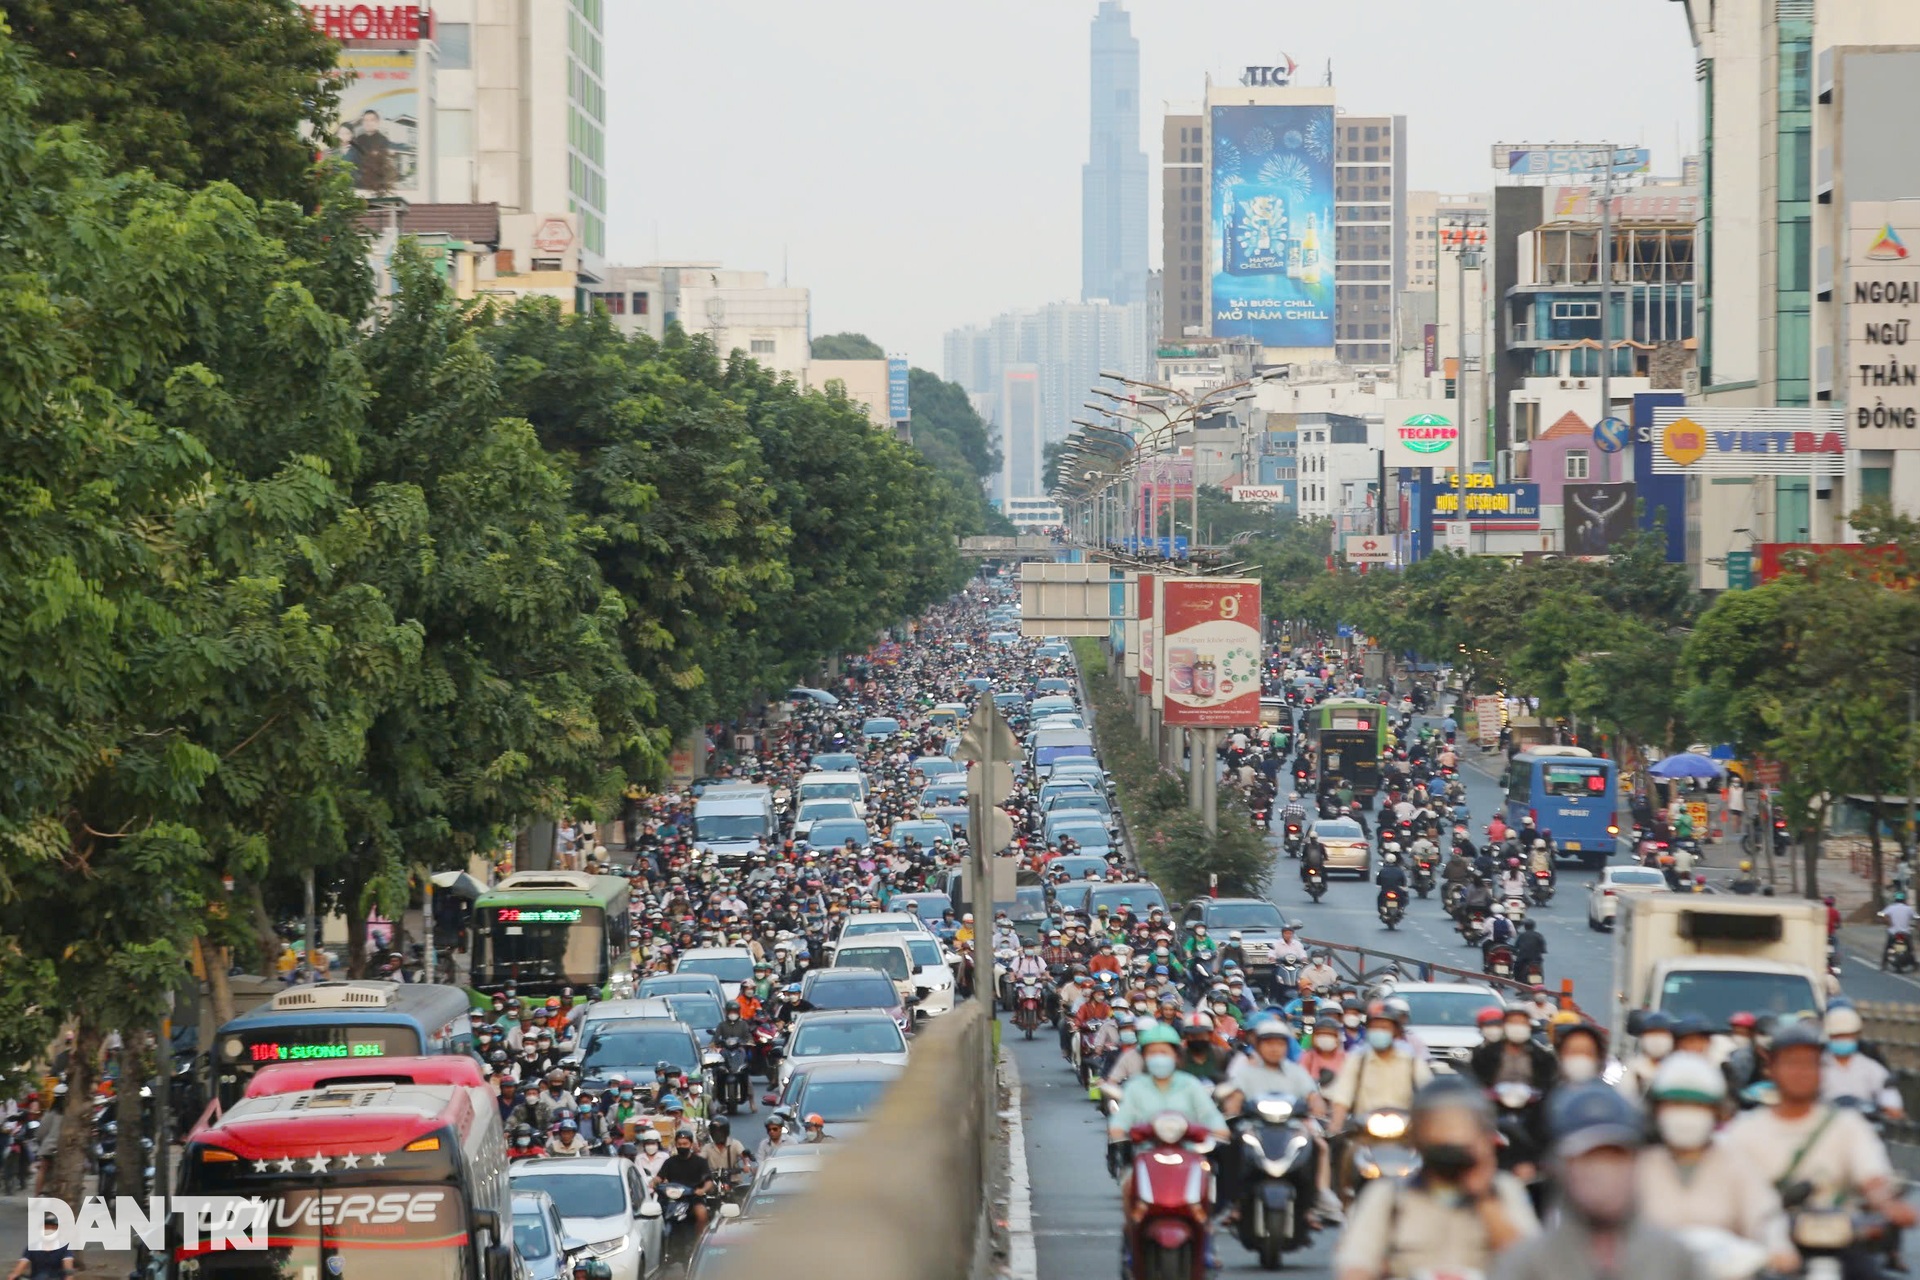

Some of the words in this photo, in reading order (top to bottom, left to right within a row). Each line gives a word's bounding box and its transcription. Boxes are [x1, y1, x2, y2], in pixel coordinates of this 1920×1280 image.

[1245, 65, 1290, 86] TTC
[1283, 299, 1316, 308] CHILL
[1854, 281, 1919, 308] NGOẠI
[1217, 307, 1243, 320] MỞ
[1285, 310, 1329, 320] CHILL
[1865, 318, 1911, 345] NGỮ
[1859, 353, 1918, 387] THẦN
[1857, 396, 1917, 429] ĐỒNG
[1398, 427, 1459, 440] TECAPRO
[1238, 489, 1279, 499] VINCOM
[1516, 506, 1536, 515] ITALY
[250, 1042, 278, 1061] 104
[199, 1192, 444, 1231] UNIVERSE
